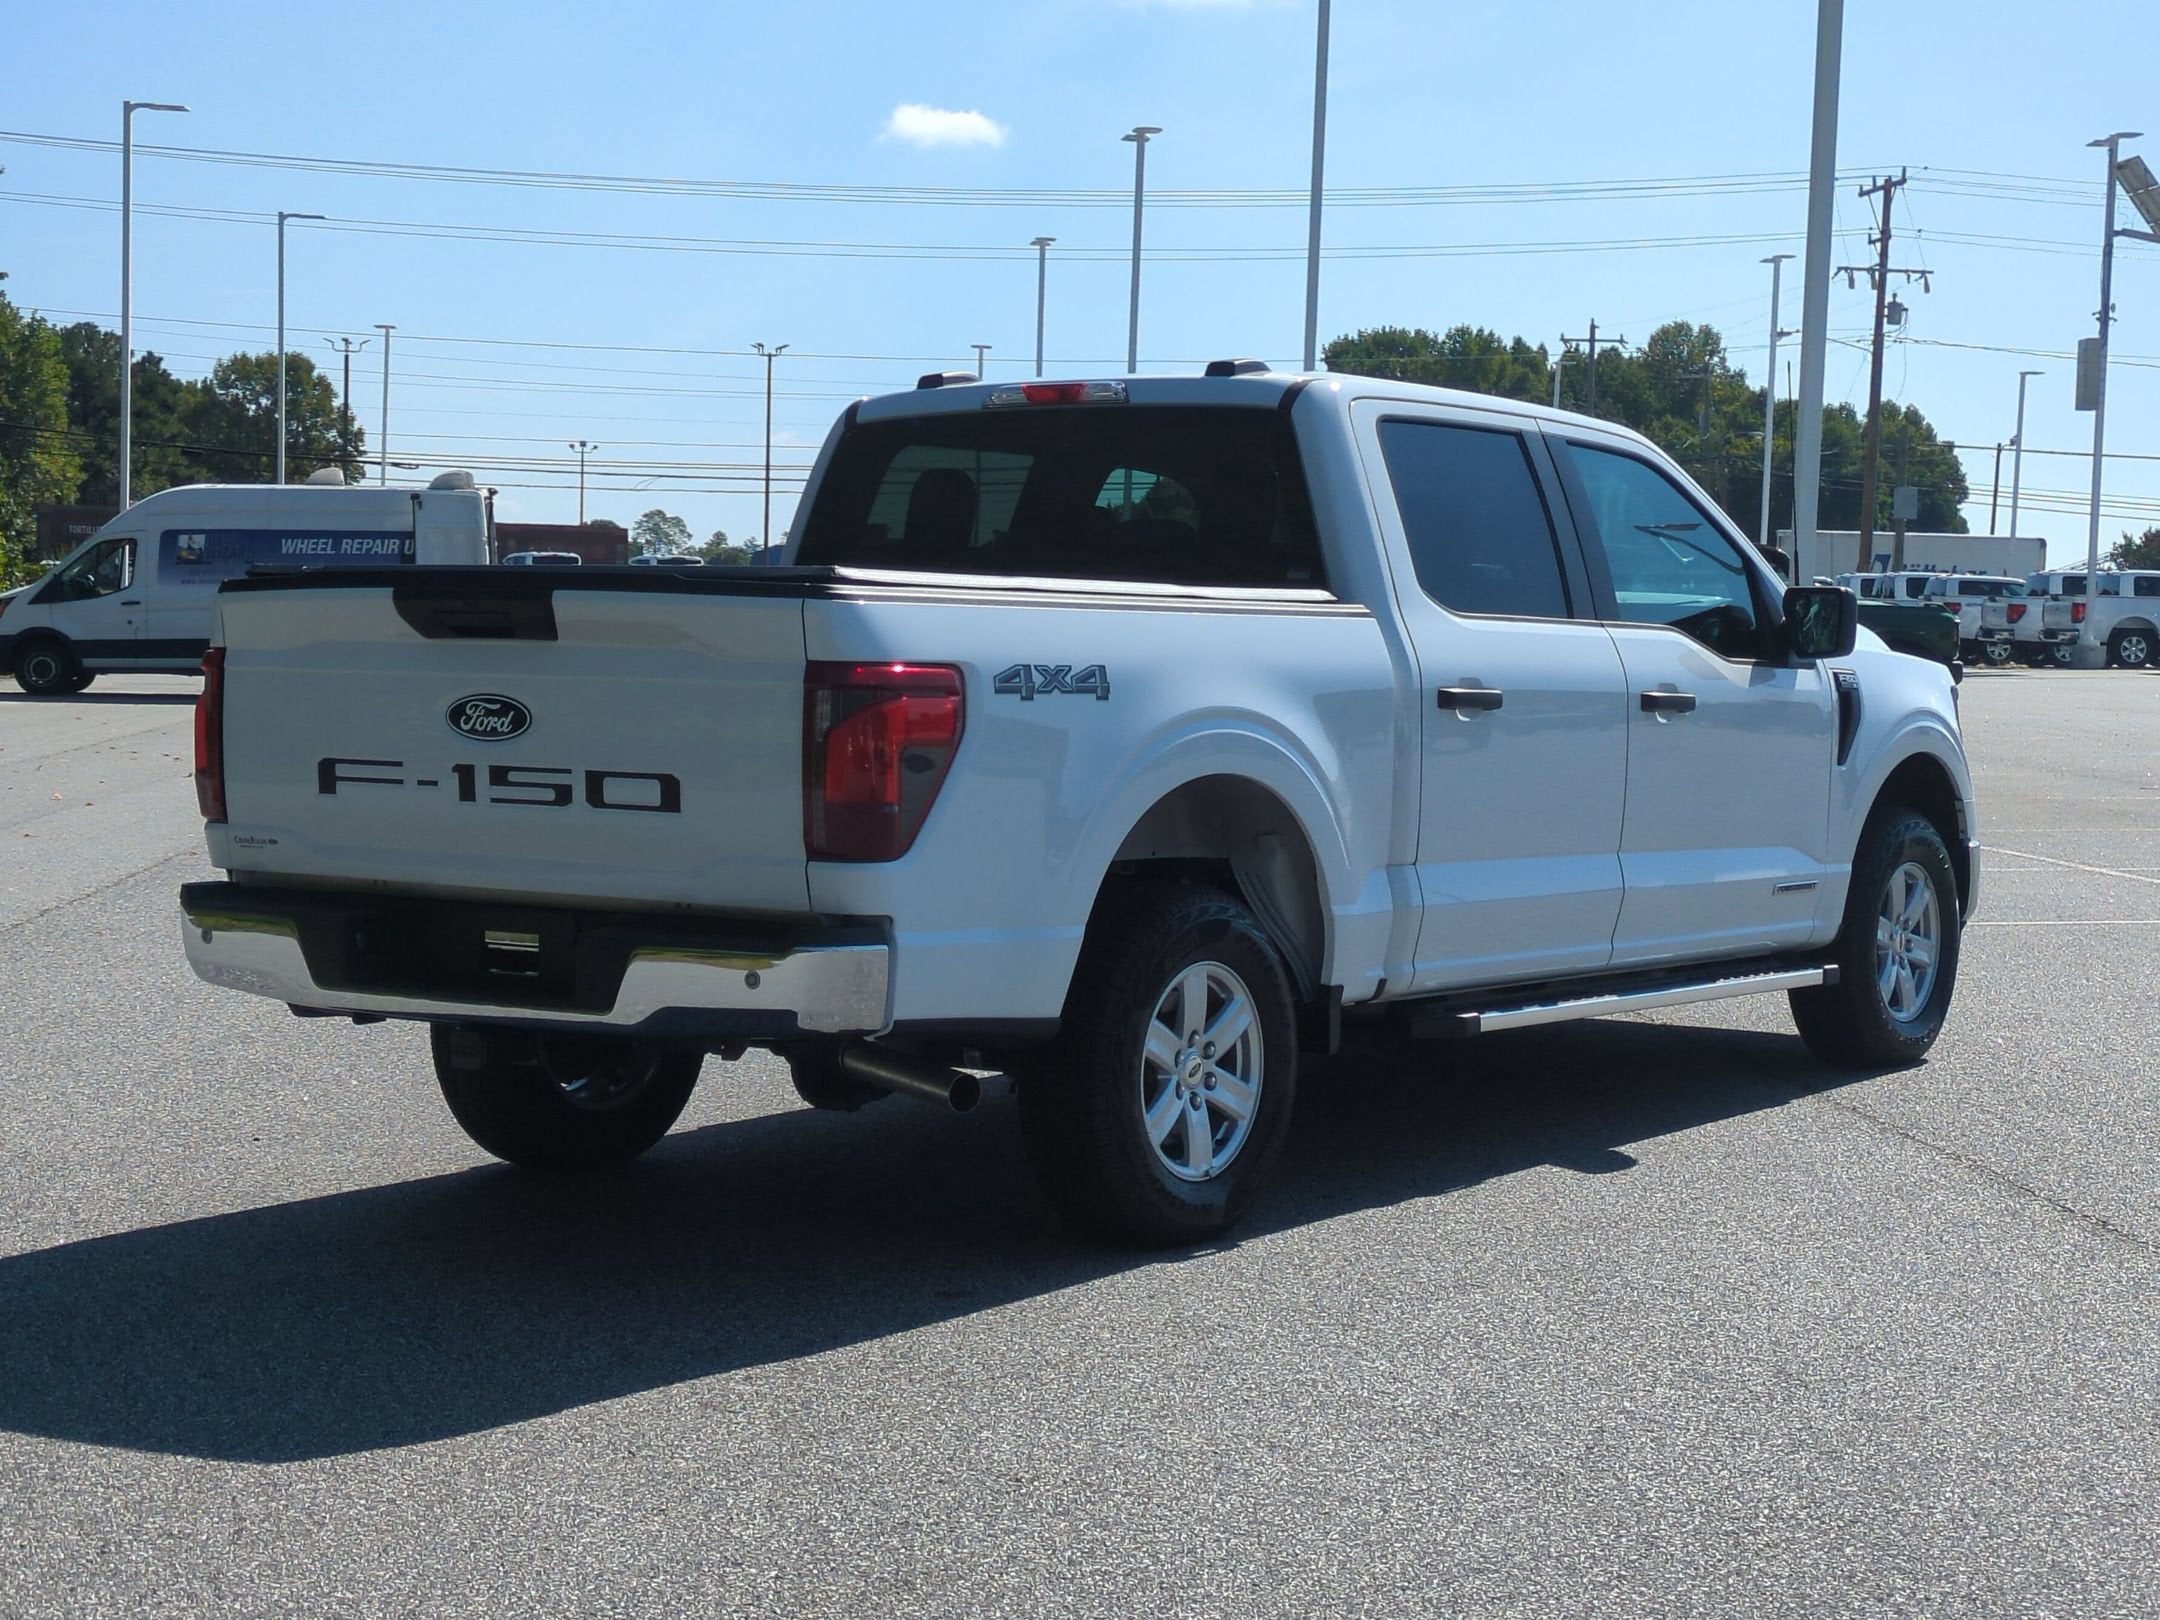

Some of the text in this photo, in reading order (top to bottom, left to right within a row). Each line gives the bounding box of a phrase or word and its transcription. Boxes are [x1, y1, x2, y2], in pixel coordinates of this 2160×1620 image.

[281, 538, 336, 554] WHEEL
[340, 538, 399, 554] REPAIR
[460, 701, 514, 733] Ford
[317, 757, 682, 813] F-150
